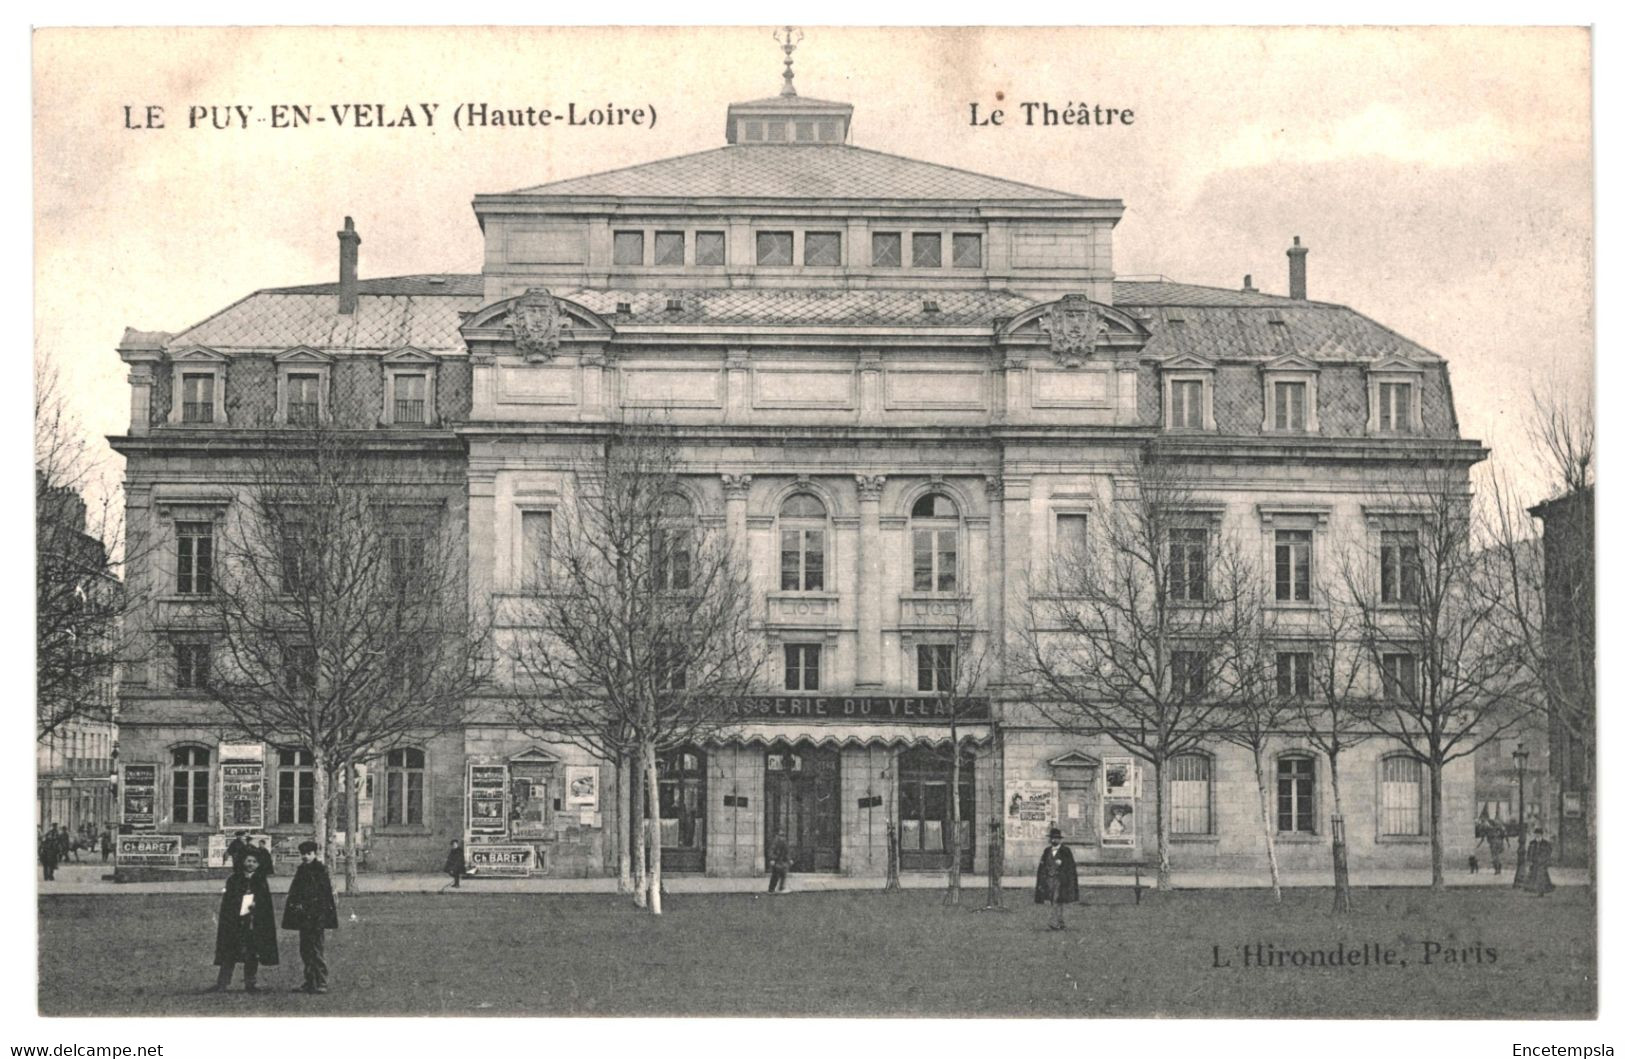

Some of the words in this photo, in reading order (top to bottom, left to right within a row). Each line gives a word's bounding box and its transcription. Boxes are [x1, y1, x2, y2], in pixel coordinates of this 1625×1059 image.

[844, 699, 872, 714] DU
[138, 842, 173, 852] BARET
[489, 853, 525, 864] BARET
